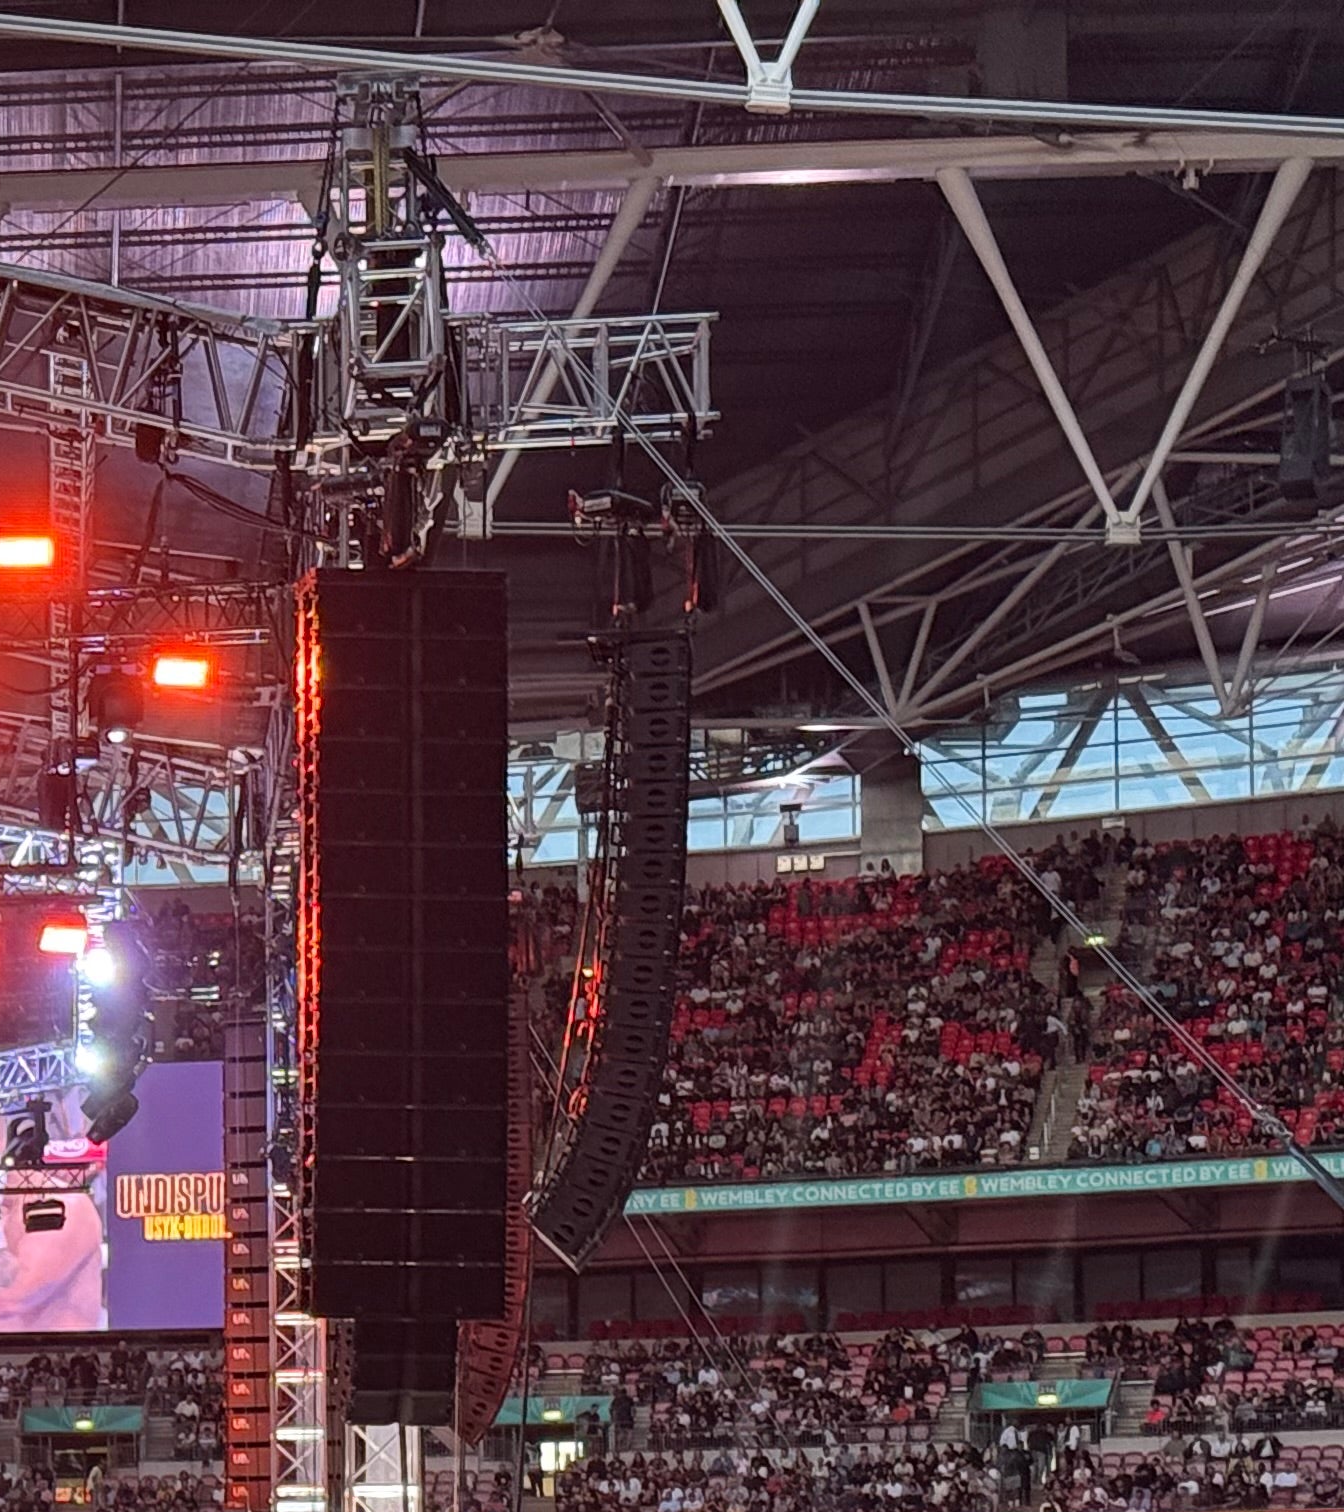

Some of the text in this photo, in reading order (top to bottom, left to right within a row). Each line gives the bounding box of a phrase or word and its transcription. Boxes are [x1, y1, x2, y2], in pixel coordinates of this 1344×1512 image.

[701, 1188, 789, 1206] WEMBLEY
[793, 1182, 907, 1202] CONNECTED
[912, 1181, 939, 1197] BY
[940, 1179, 960, 1196] EE
[981, 1174, 1072, 1193] WEMBLEY
[1076, 1166, 1196, 1190] CONNECTED
[1200, 1165, 1226, 1182] BY
[1229, 1163, 1251, 1180] EE
